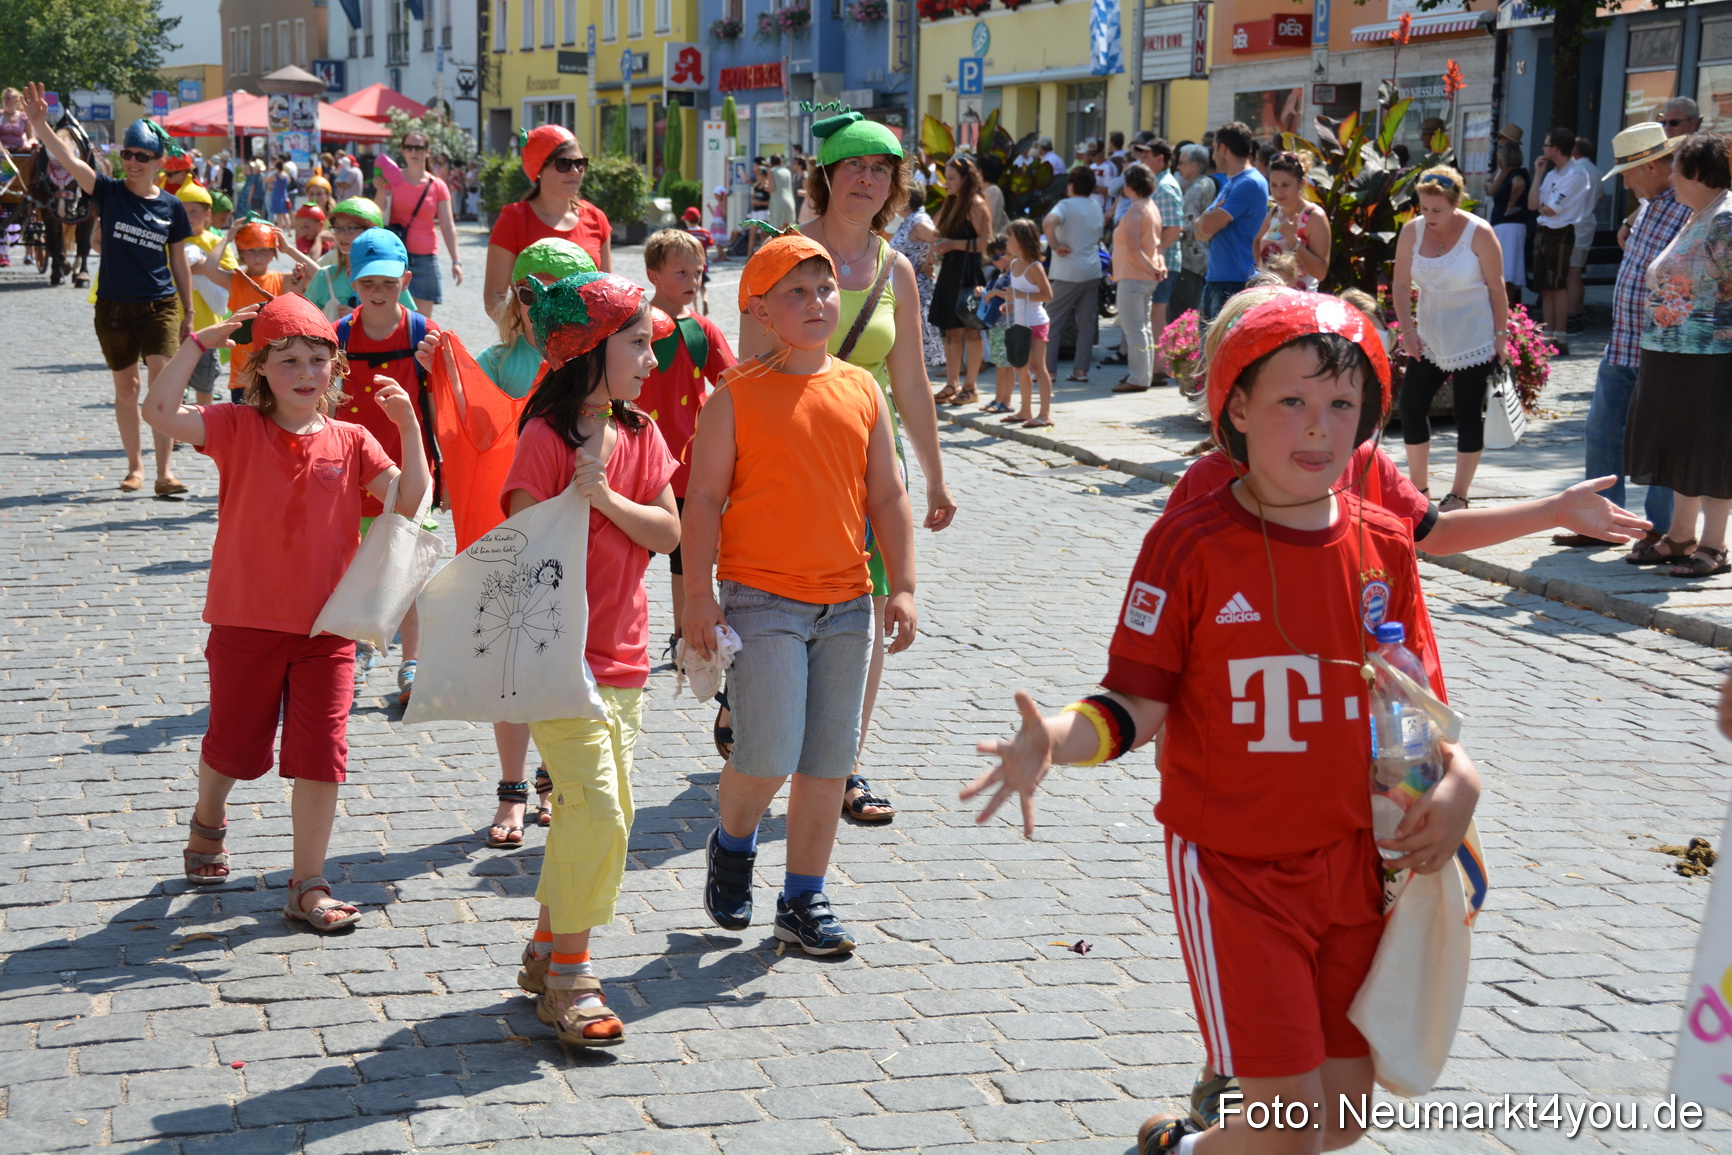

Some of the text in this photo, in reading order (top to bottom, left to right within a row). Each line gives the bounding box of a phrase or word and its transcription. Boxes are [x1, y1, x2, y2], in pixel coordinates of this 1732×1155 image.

[1278, 20, 1304, 36] DER
[1316, 0, 1328, 37] P
[1195, 4, 1206, 72] KINO
[316, 63, 341, 87] KL
[526, 76, 561, 92] Restaurant
[718, 62, 782, 92] APOTHEKE
[963, 61, 979, 92] P
[1129, 609, 1153, 623] BUNDES
[1130, 618, 1145, 628] LIGA
[1215, 611, 1261, 624] adidas
